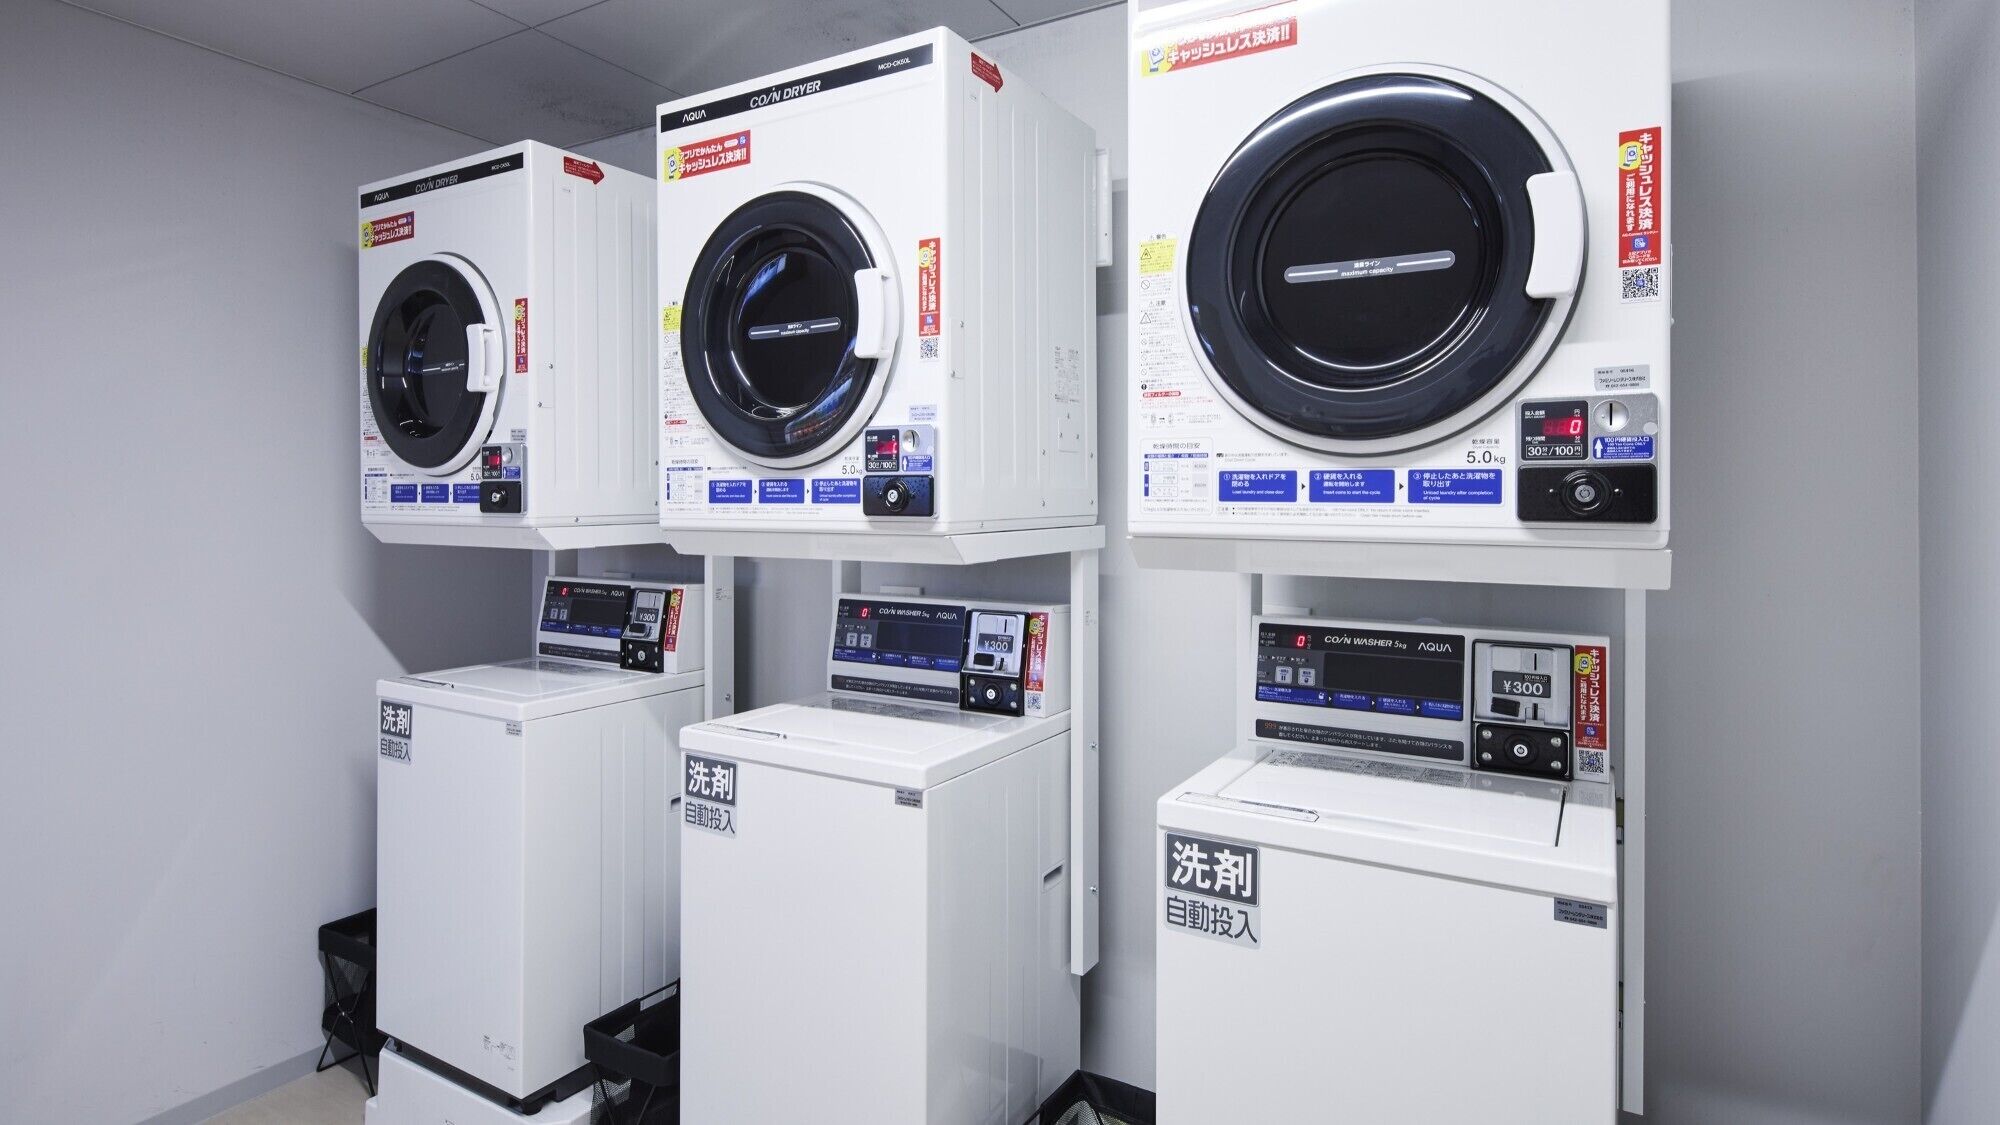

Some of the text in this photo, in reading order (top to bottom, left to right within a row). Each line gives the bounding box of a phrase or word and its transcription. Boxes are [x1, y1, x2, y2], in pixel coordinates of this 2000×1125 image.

[783, 79, 821, 100] DRYER
[682, 109, 706, 123] AQUA
[435, 174, 458, 188] DRYER
[1638, 132, 1653, 231] キャッシュレス決済
[1340, 266, 1394, 277] maximum capacity
[1569, 419, 1582, 435] 0
[1466, 450, 1506, 465] 5.0 kg
[639, 612, 656, 622] ¥300
[861, 607, 868, 617] 0
[896, 608, 922, 617] WASHER
[936, 611, 957, 620] AQUA
[984, 640, 1008, 651] ¥300
[1297, 635, 1305, 647] 0
[1353, 637, 1393, 648] WASHER
[1393, 640, 1407, 650] 5kg
[1417, 641, 1452, 652] AQUA
[1503, 680, 1543, 695] ¥300
[1589, 648, 1600, 723] キャッシュレス決済
[382, 704, 410, 735] 洗剤
[380, 737, 411, 762] 自動投入
[688, 759, 734, 801] 洗剤
[685, 800, 735, 835] 自動投入
[1171, 840, 1253, 898] 洗剤
[1166, 895, 1258, 944] 自動投入
